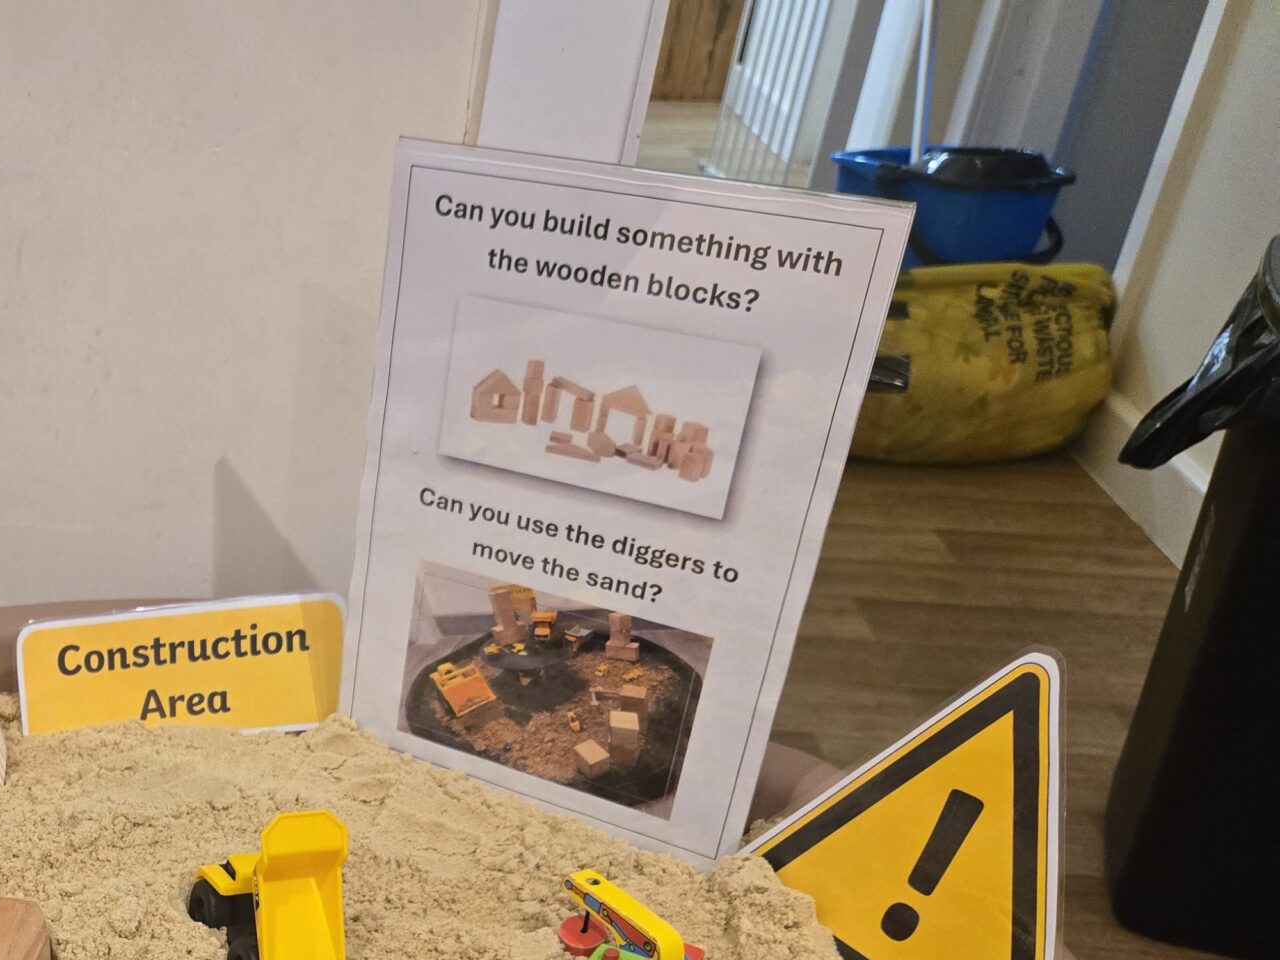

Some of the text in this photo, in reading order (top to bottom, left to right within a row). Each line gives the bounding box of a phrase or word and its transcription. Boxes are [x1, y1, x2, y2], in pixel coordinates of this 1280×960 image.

[435, 194, 843, 277] Can you build something with
[488, 249, 760, 313] the wooden blocks?
[419, 487, 740, 584] Can you use the diggers to
[472, 542, 664, 605] move the sand?
[57, 623, 310, 676] Construction
[140, 688, 231, 721] Area
